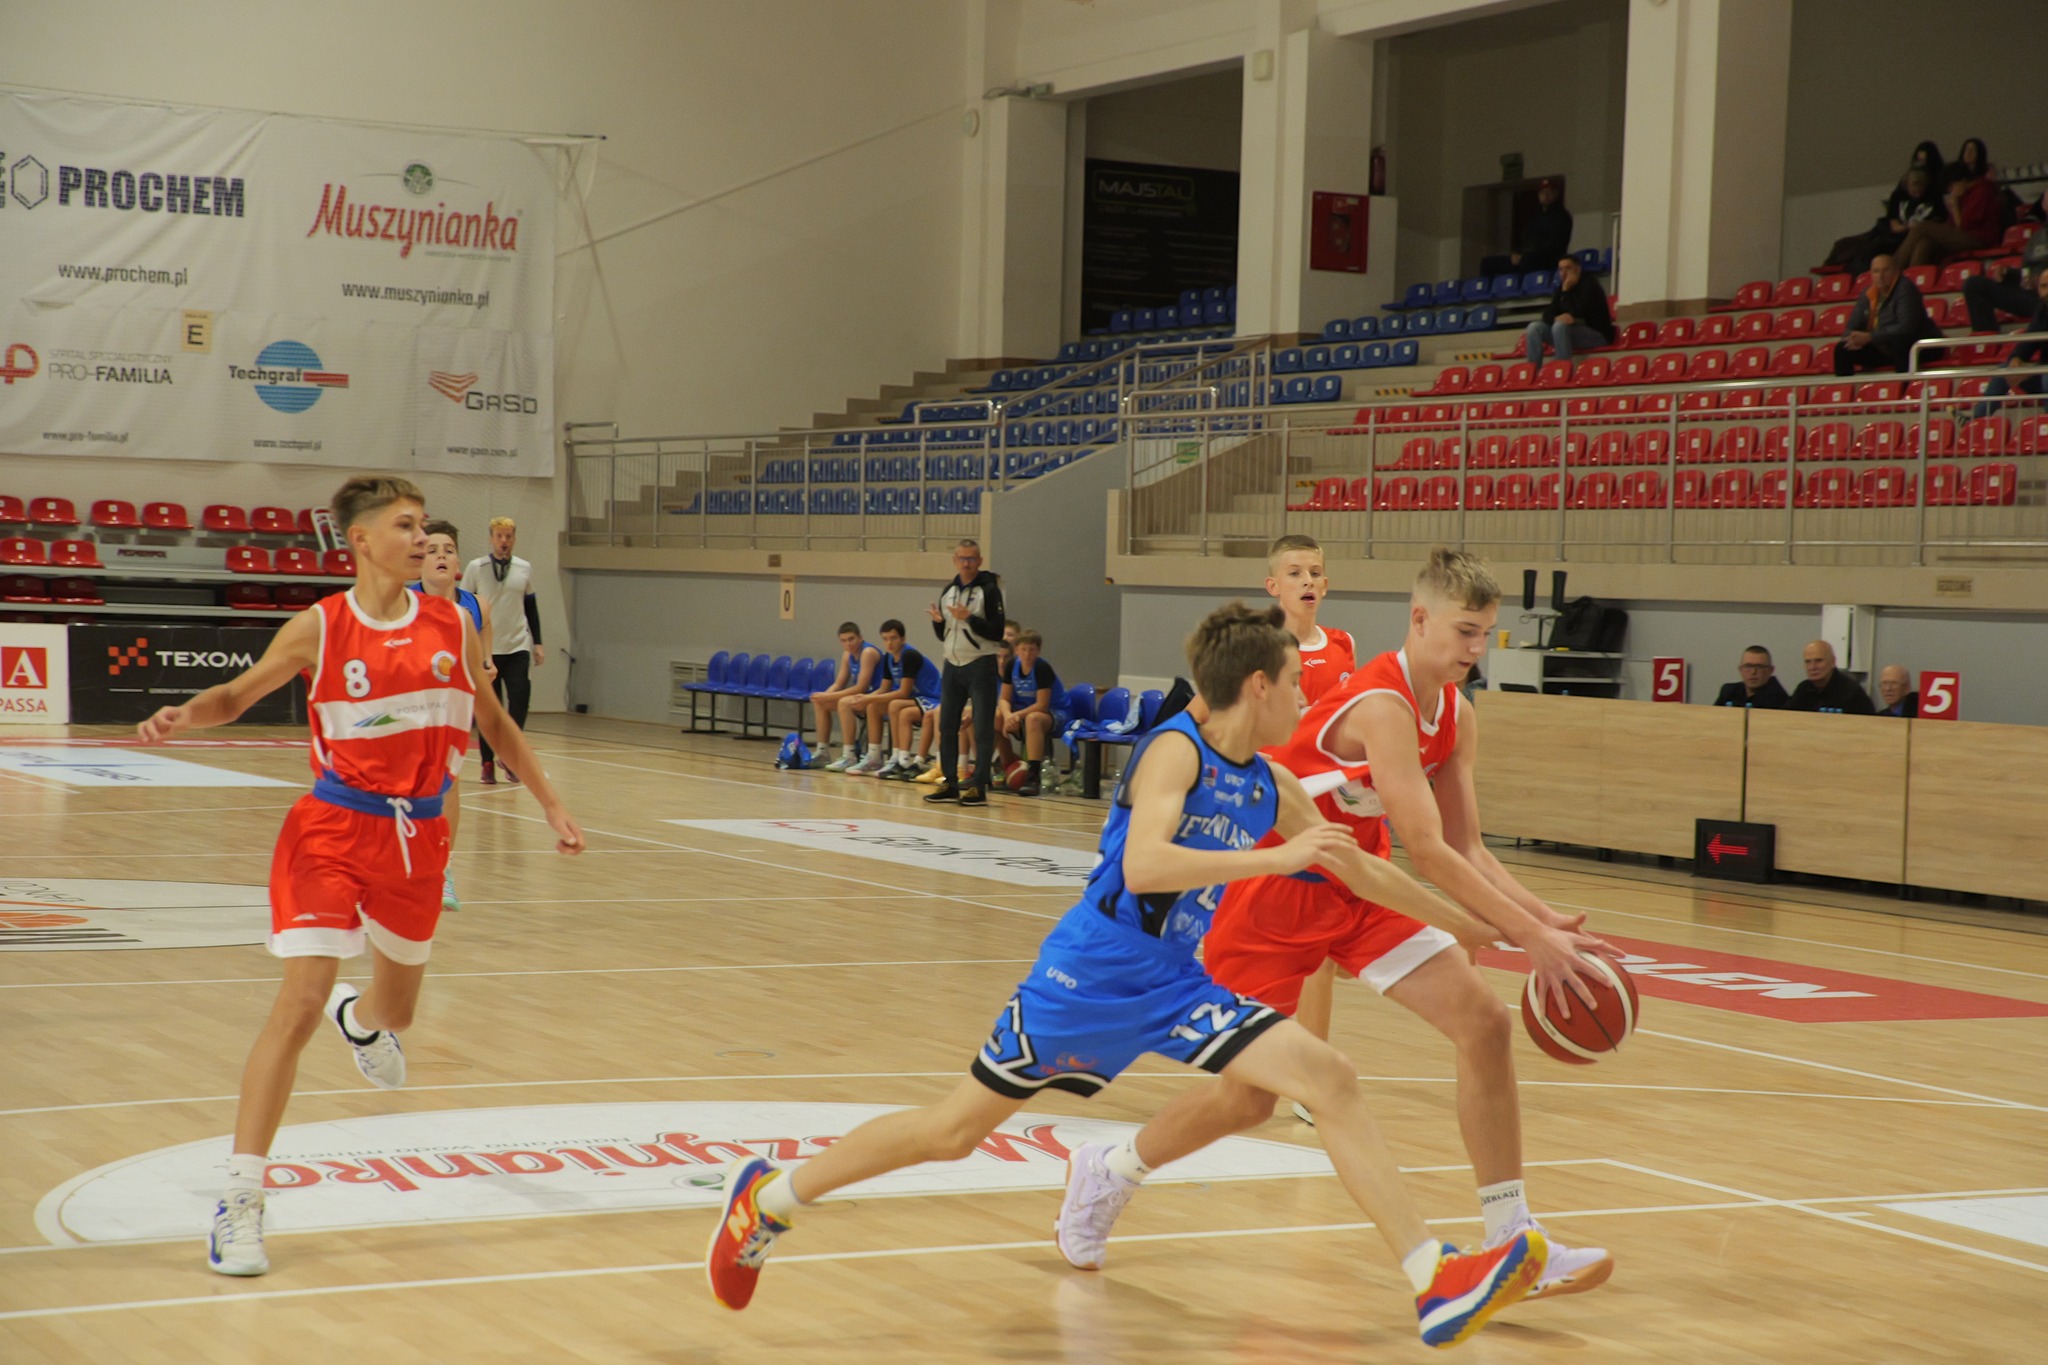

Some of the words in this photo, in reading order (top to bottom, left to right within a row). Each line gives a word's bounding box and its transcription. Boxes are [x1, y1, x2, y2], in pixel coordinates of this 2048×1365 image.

[58, 165, 245, 218] PROCHEM
[307, 183, 518, 259] Muszynianka
[58, 264, 188, 287] www.prochem.pl
[342, 282, 490, 309] www.muszynianka.pl
[187, 324, 204, 346] E
[48, 362, 173, 384] PRO-FAMILIA
[228, 365, 302, 385] Techgraf
[155, 650, 254, 668] TEXOM
[343, 659, 371, 698] 8
[1657, 663, 1680, 697] 5
[1922, 677, 1955, 714] 5
[961, 856, 1096, 881] Peka
[261, 1123, 1072, 1193] Mzynianka
[395, 1145, 475, 1153] woda
